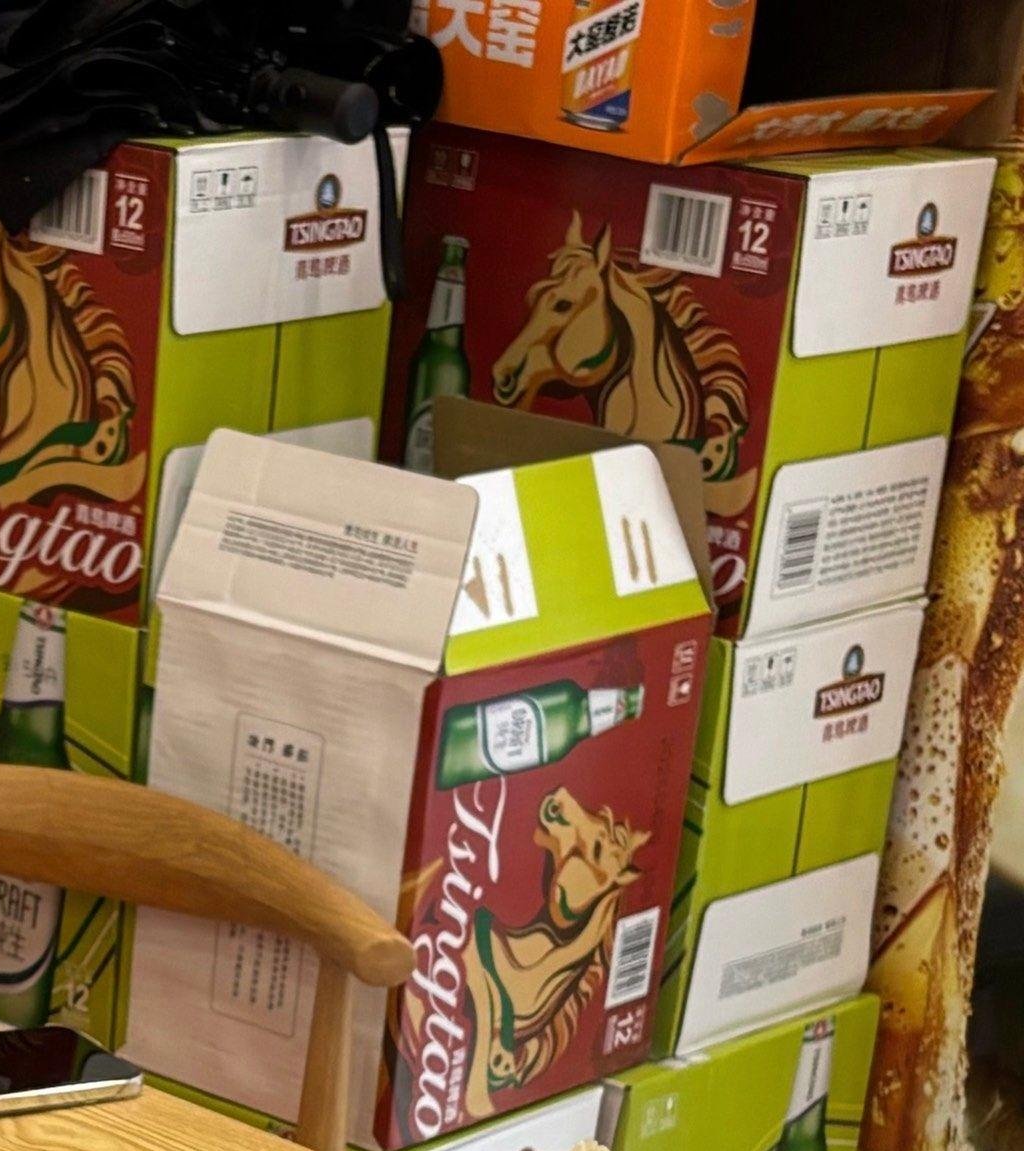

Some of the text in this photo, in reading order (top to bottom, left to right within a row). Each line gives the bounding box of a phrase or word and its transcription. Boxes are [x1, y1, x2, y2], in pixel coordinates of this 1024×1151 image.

[115, 195, 145, 231] 12
[289, 215, 364, 246] TSINGTAO
[738, 219, 770, 255] 12
[412, 776, 507, 1139] Tsingtao
[613, 1011, 634, 1048] 12
